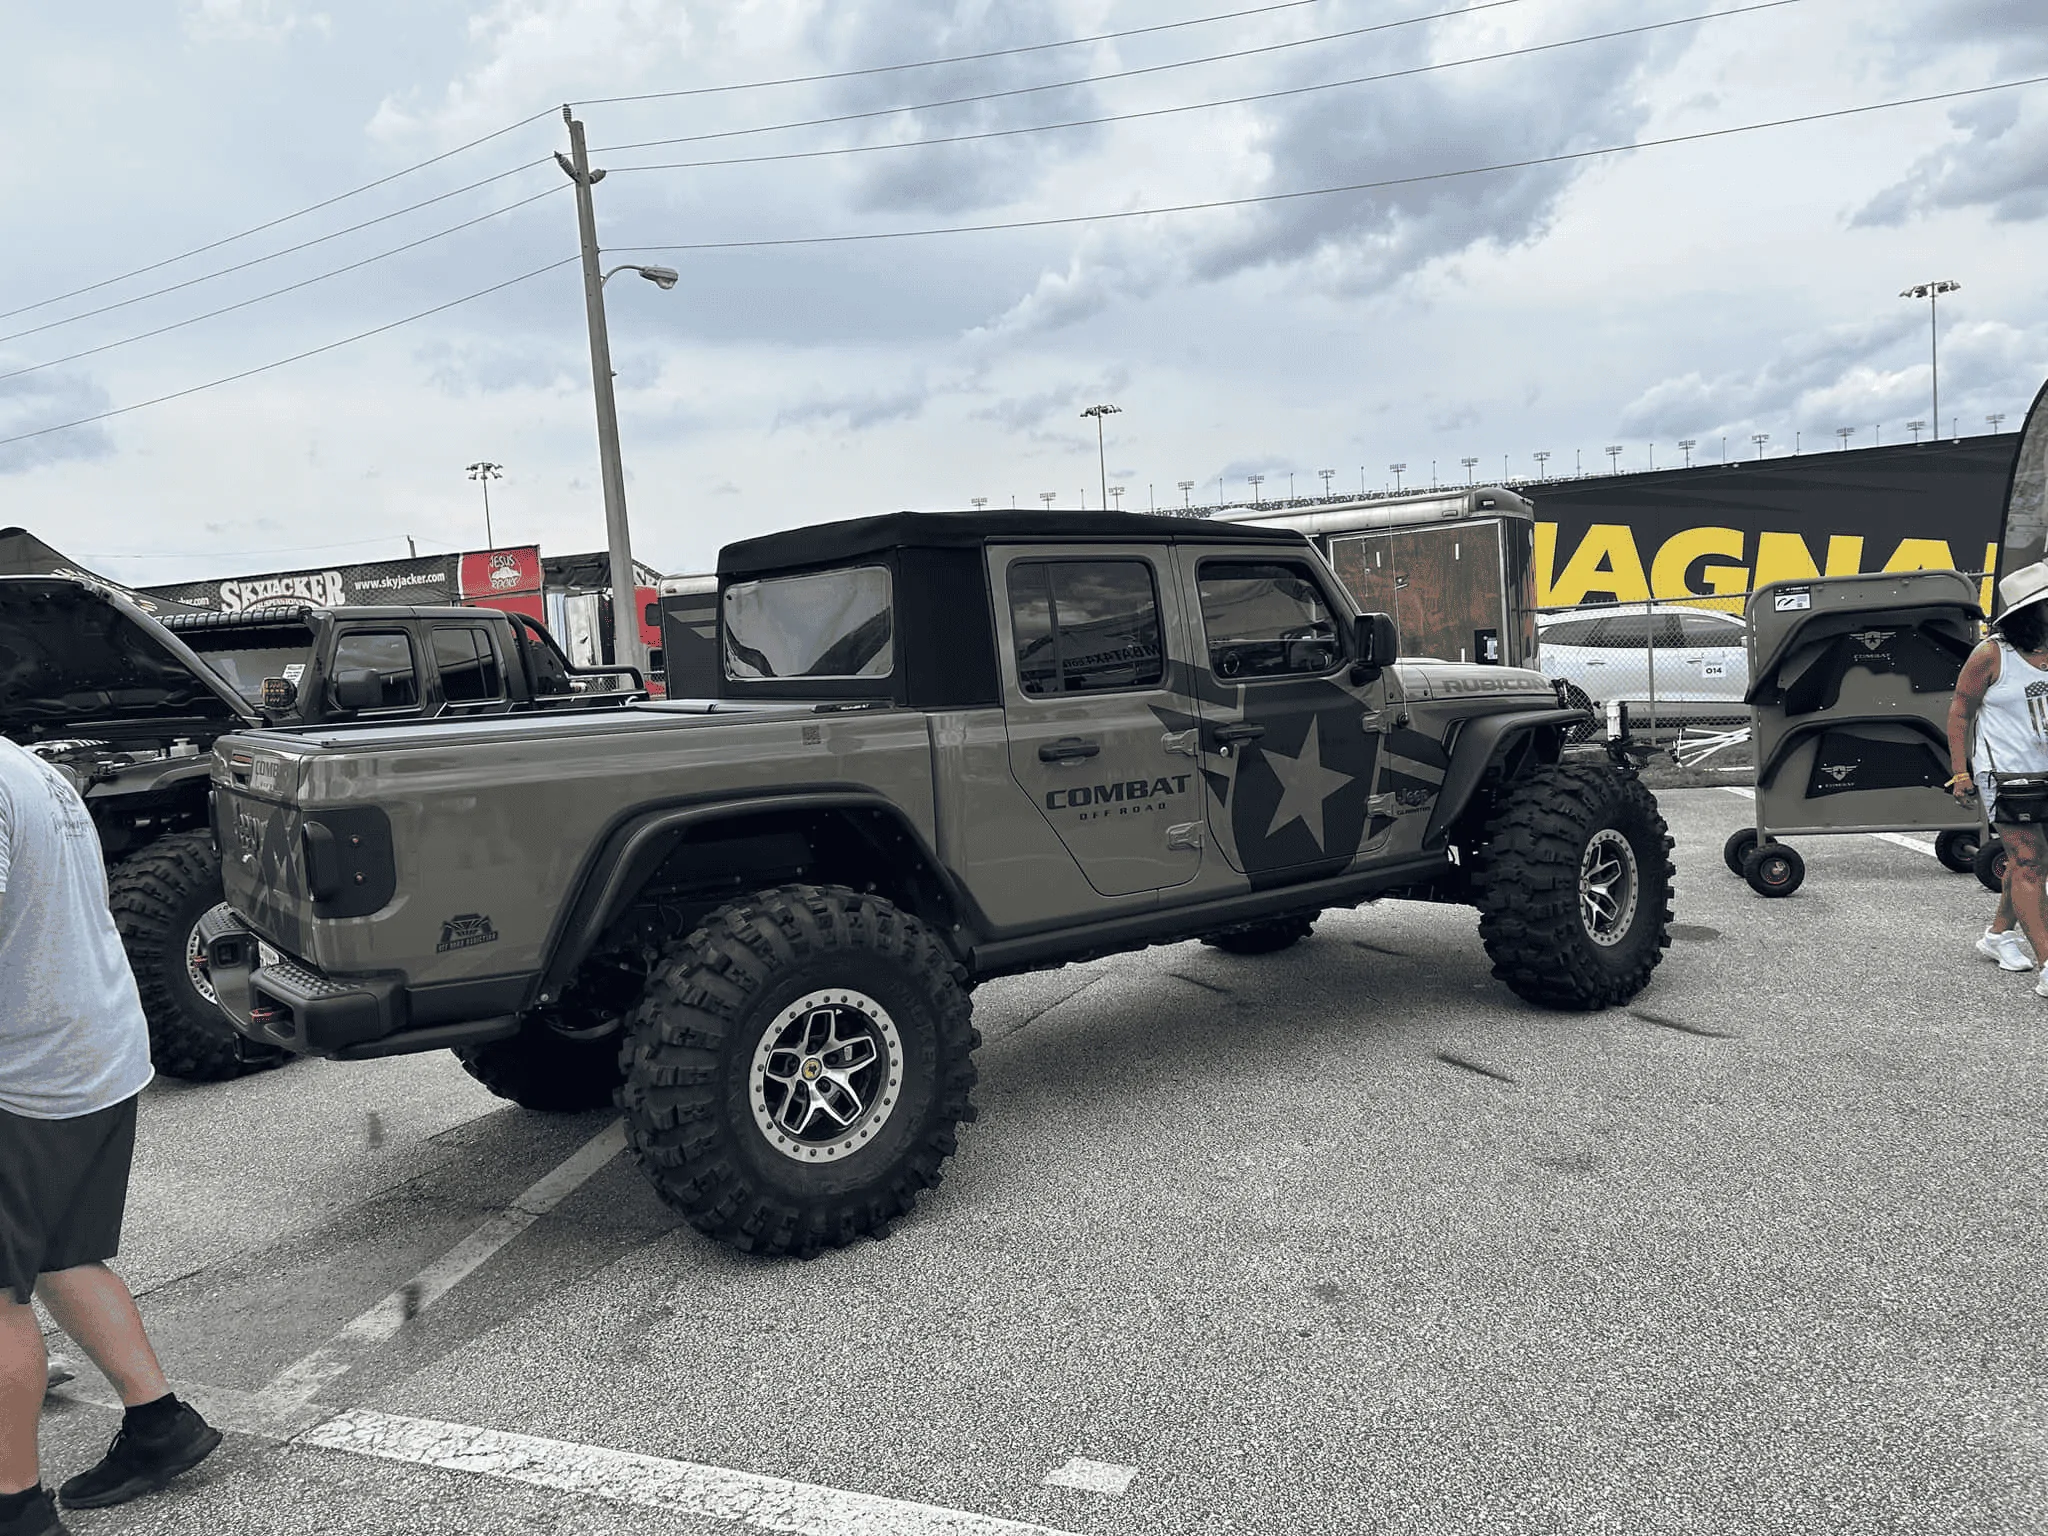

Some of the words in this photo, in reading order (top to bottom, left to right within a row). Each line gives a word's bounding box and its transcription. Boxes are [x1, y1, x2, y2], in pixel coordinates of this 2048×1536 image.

[490, 554, 516, 568] JESUS
[219, 571, 346, 612] SKYJACKER
[354, 572, 446, 592] www.skyjacker.com
[1442, 678, 1549, 694] RUBICON
[1046, 774, 1191, 810] COMBAT
[1079, 810, 1111, 821] OFF
[1119, 802, 1166, 816] ROAD
